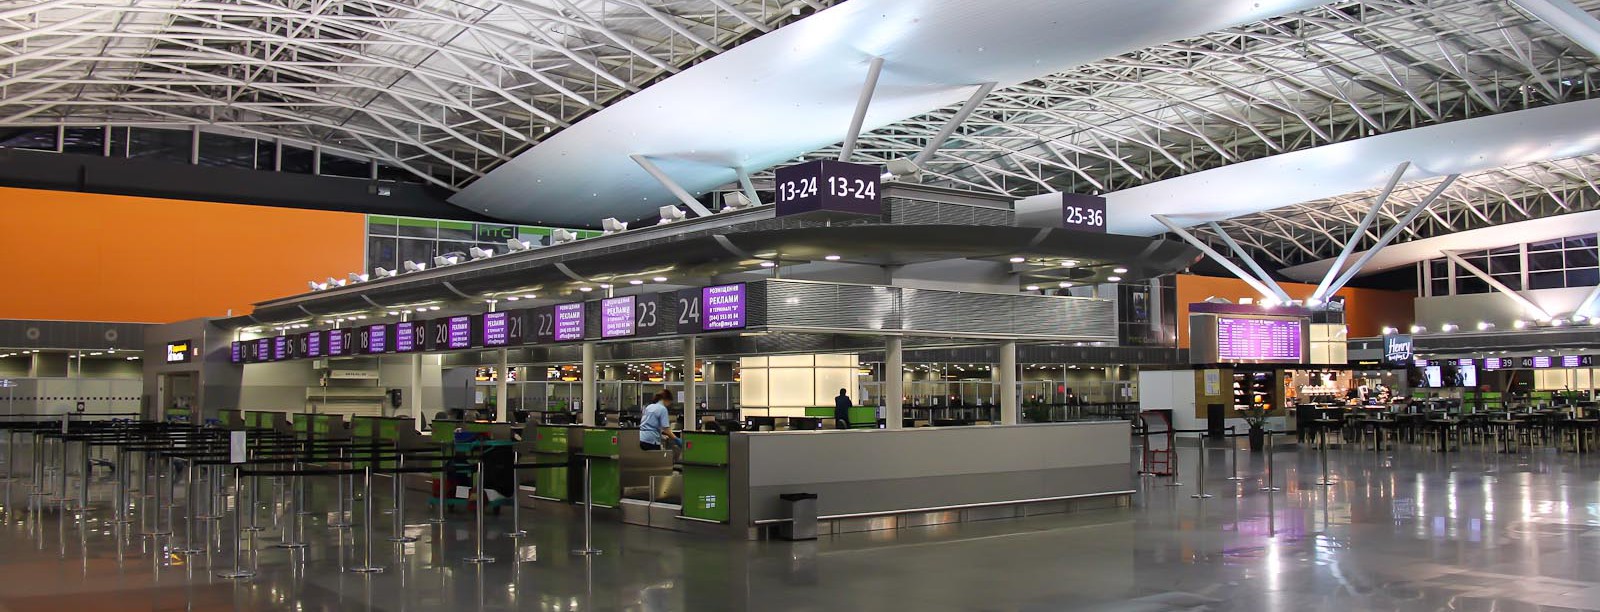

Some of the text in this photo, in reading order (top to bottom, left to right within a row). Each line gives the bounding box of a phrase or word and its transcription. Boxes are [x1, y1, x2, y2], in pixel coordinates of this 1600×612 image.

[780, 176, 818, 201] 13-24
[828, 176, 875, 200] 13-24
[1066, 206, 1103, 227] 25-36
[709, 294, 739, 305] РЕКЛАМИ
[638, 301, 656, 327] 23
[679, 296, 700, 324] 24
[436, 323, 448, 343] 20
[510, 316, 522, 338] 21
[538, 313, 553, 336] 22
[300, 337, 307, 353] 16
[344, 332, 351, 350] 17
[360, 331, 368, 349] 18
[416, 326, 425, 345] 19
[287, 339, 293, 354] 15
[1389, 337, 1410, 360] Henry
[1502, 359, 1512, 367] 39
